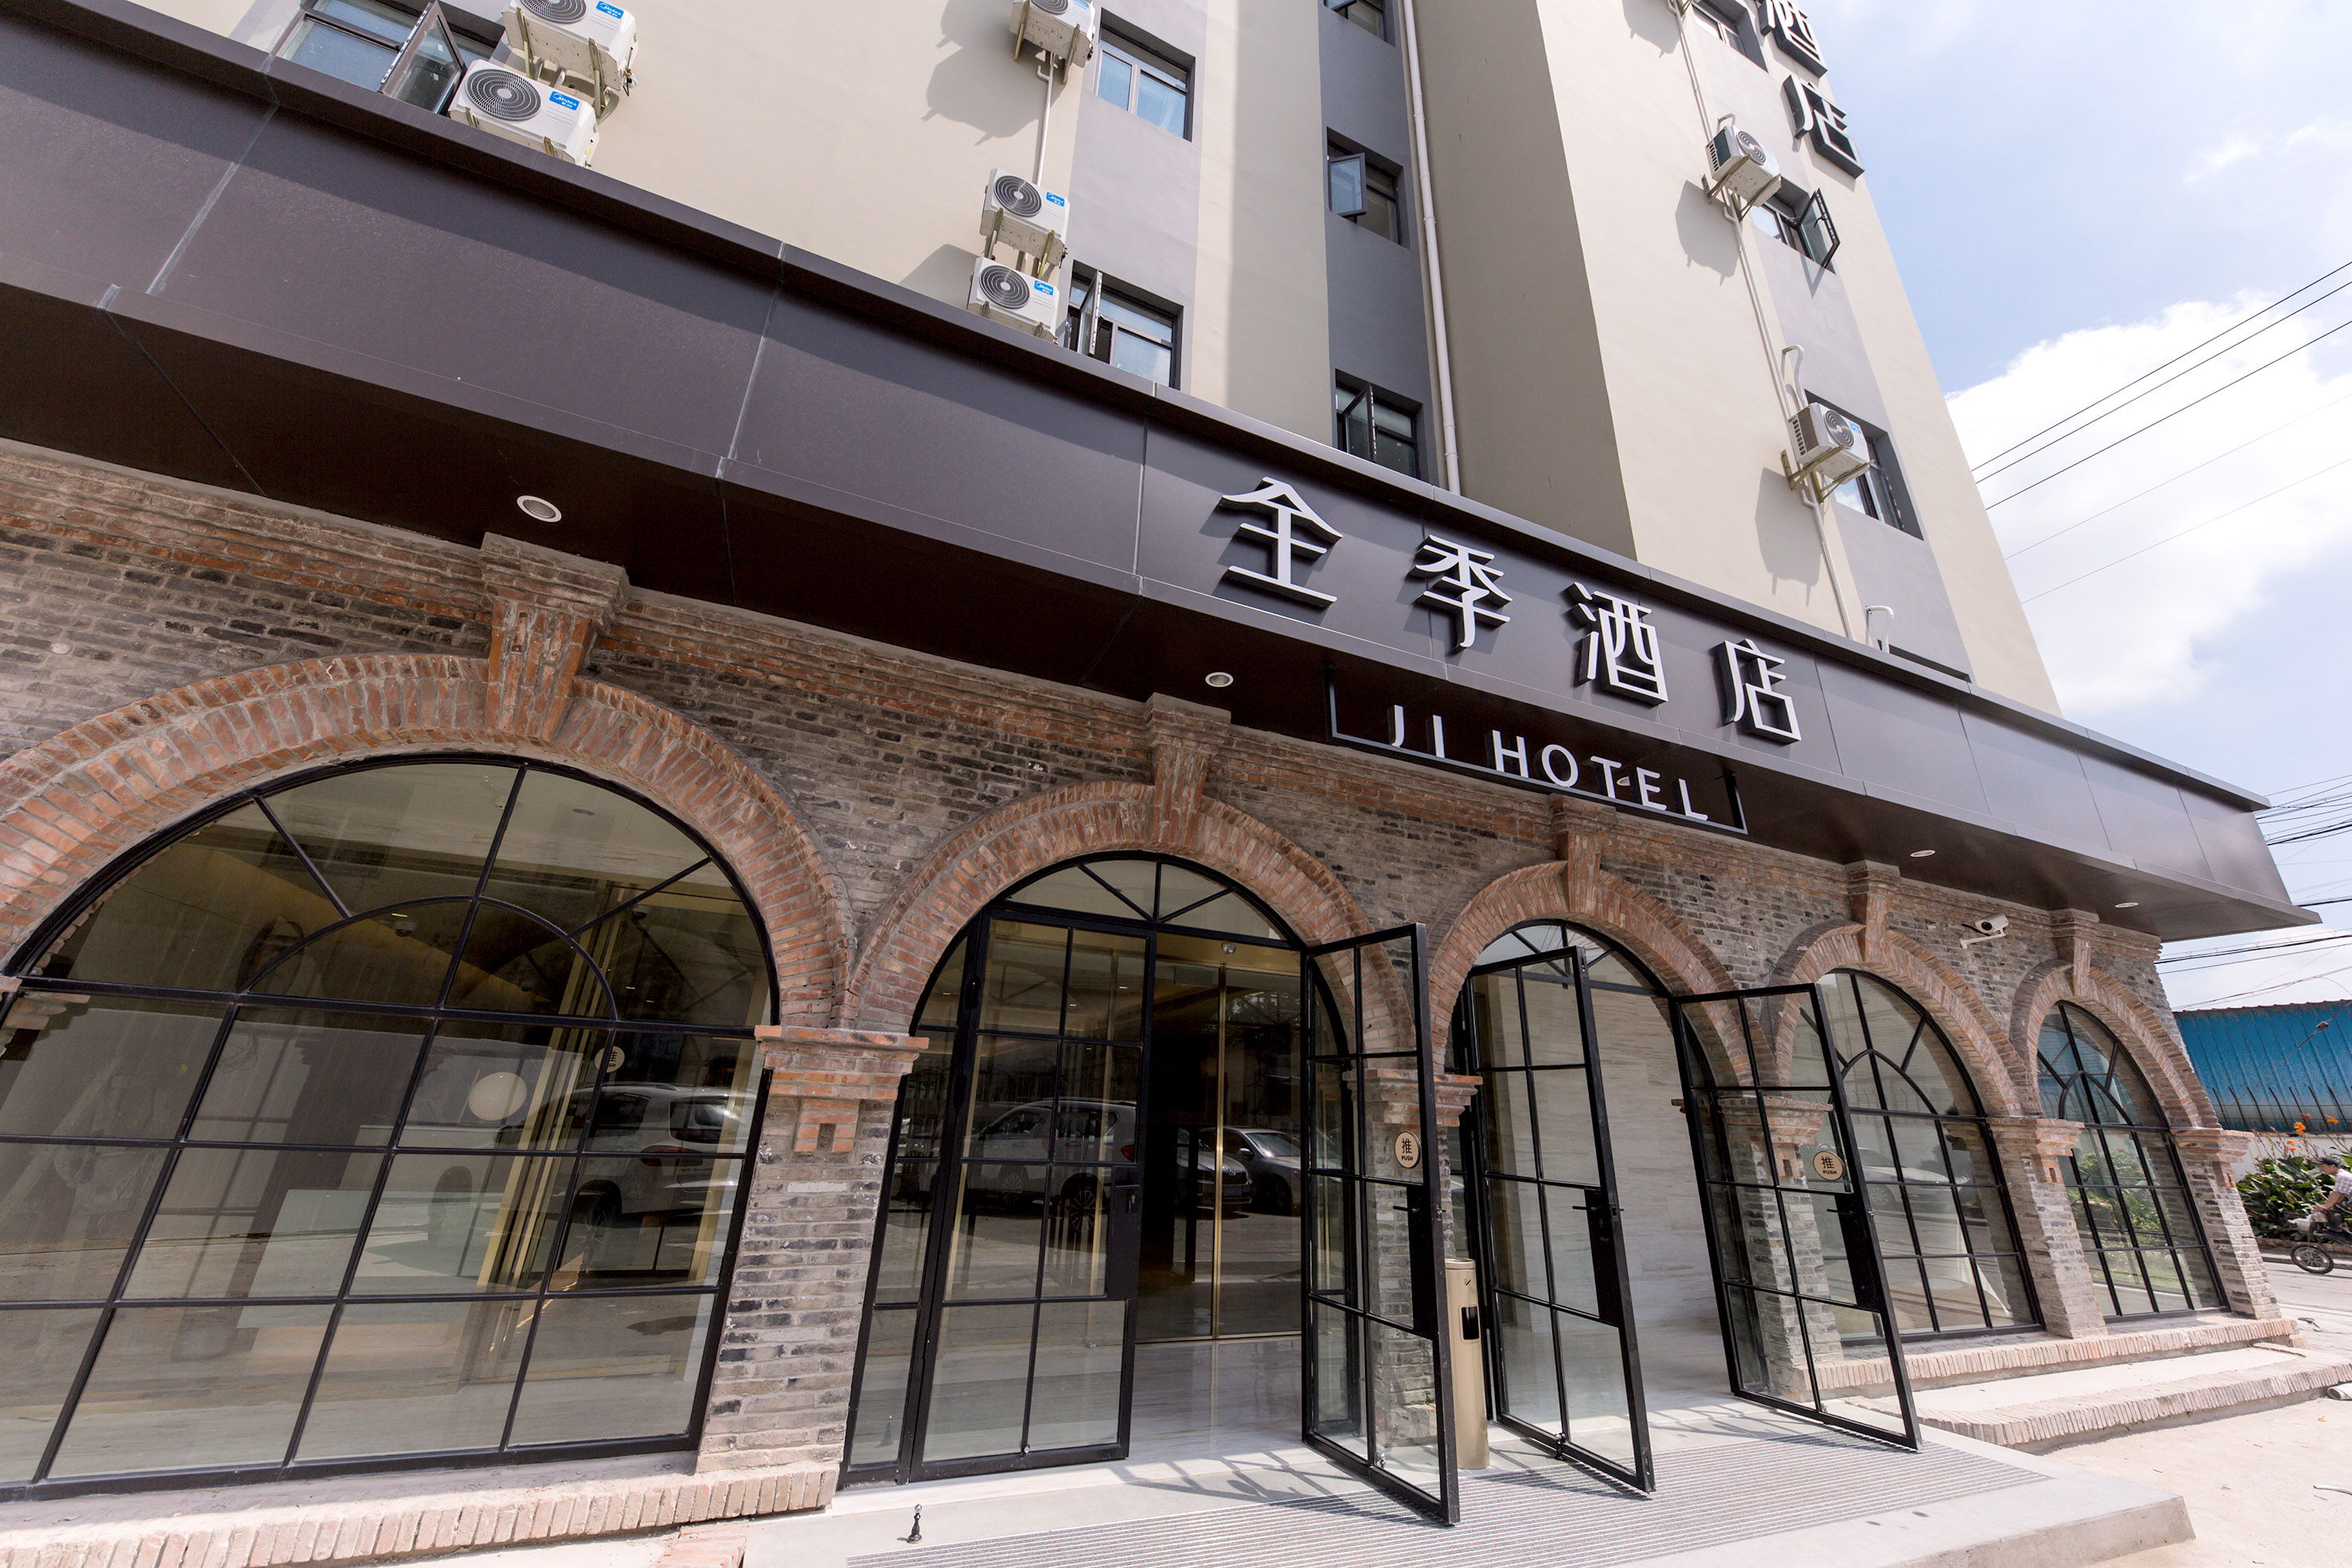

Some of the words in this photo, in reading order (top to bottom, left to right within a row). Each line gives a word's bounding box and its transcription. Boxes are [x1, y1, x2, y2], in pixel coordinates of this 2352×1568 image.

[554, 93, 577, 106] Midea
[1221, 476, 1802, 742] 全季酒店
[1389, 704, 1445, 758] JI
[1489, 729, 1708, 820] HOTEL
[1402, 1138, 1412, 1153] 推
[1821, 1156, 1834, 1168] 推
